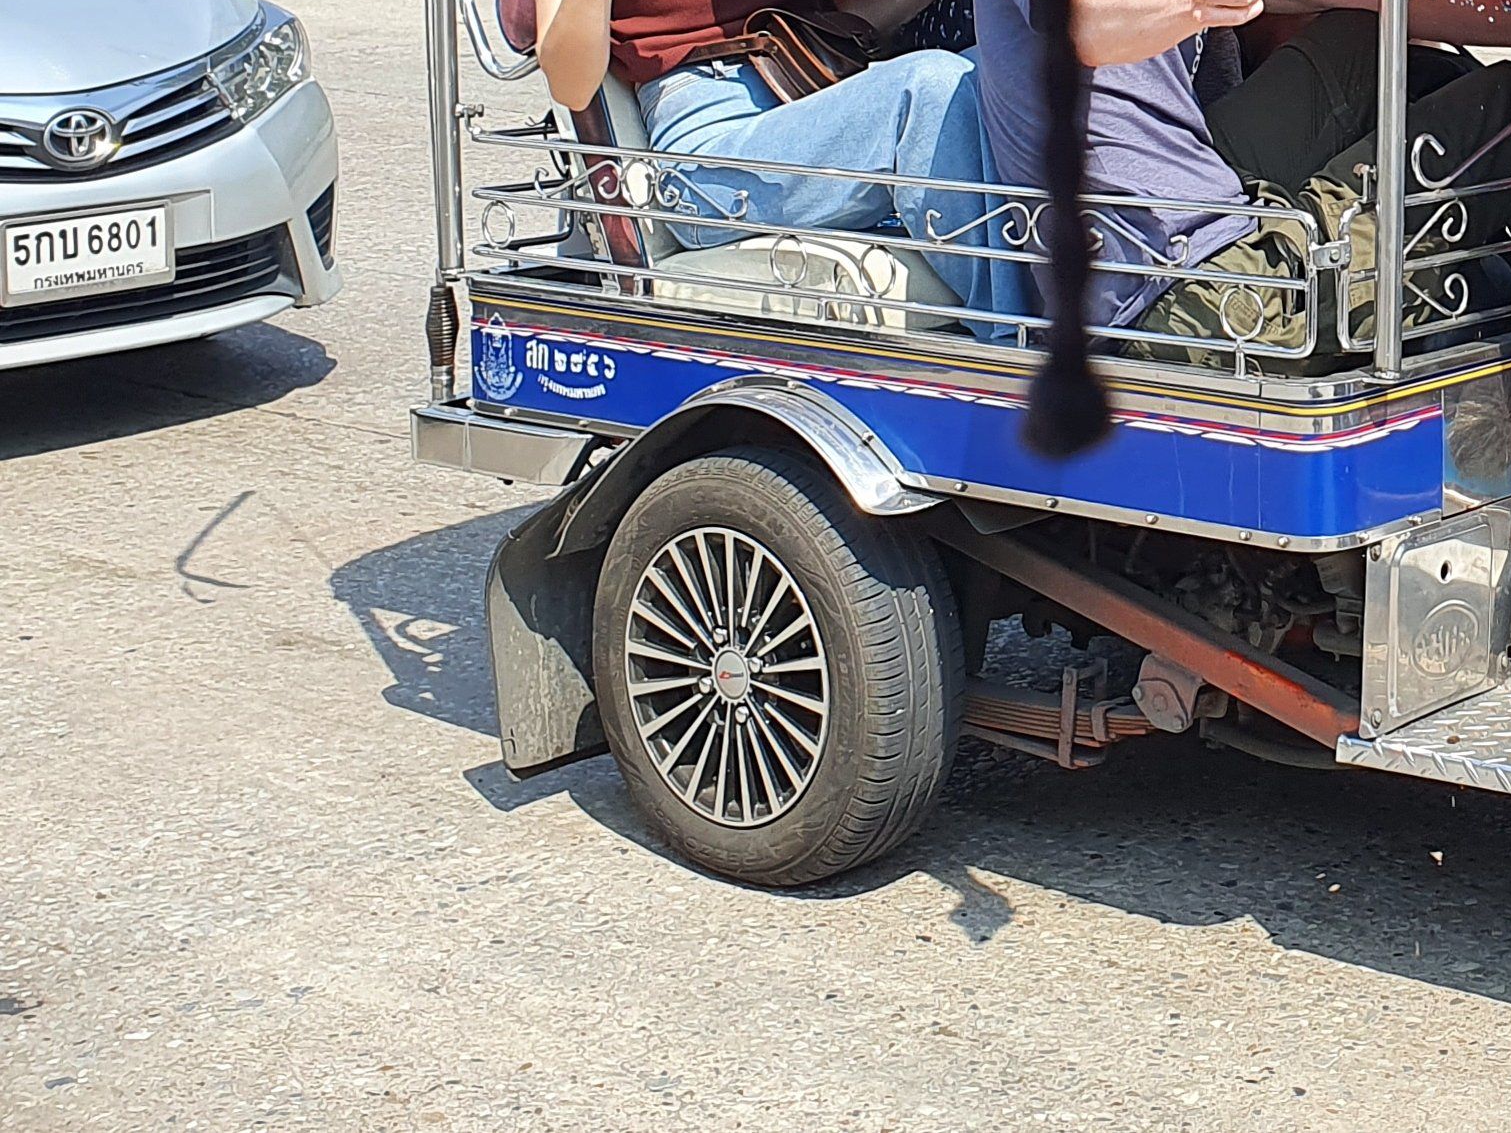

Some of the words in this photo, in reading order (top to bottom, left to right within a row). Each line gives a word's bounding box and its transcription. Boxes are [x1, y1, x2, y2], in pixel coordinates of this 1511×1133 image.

[13, 226, 79, 266] 5กบ
[87, 215, 158, 255] 6801
[33, 261, 144, 290] กรงเทพมหานคร
